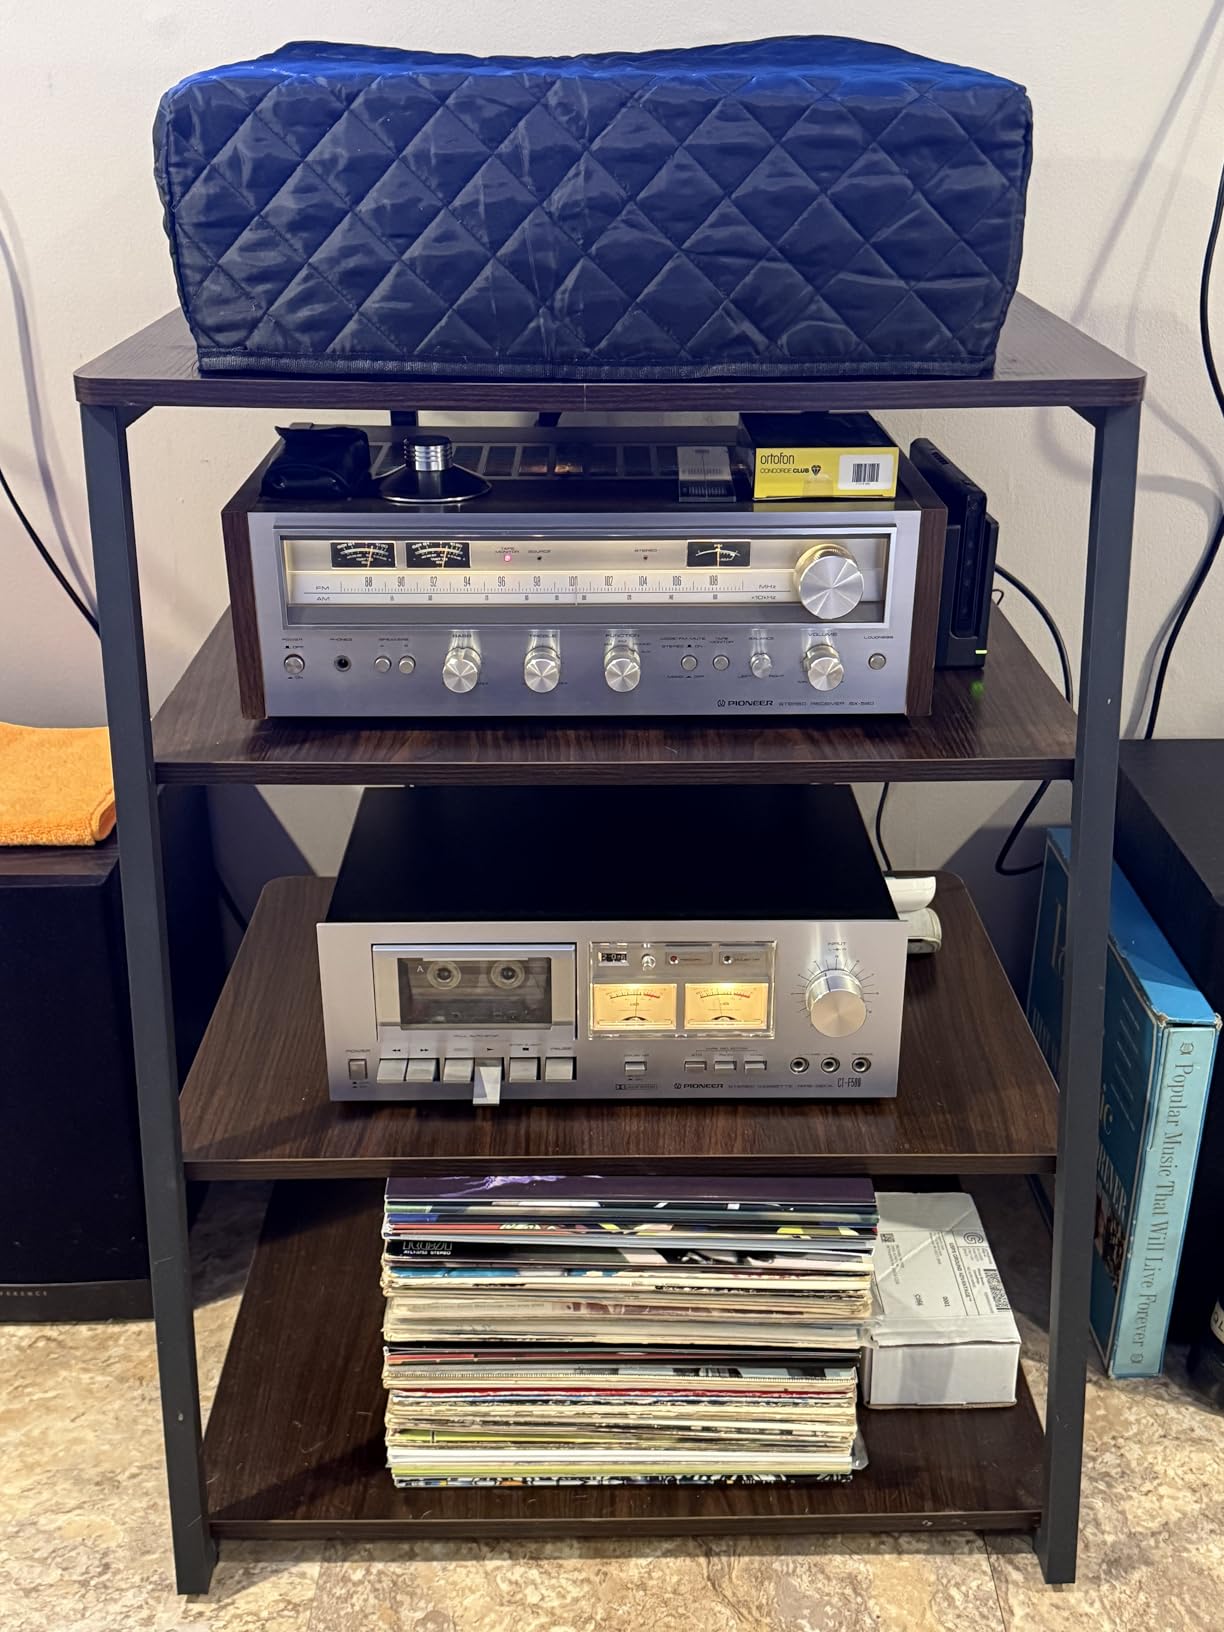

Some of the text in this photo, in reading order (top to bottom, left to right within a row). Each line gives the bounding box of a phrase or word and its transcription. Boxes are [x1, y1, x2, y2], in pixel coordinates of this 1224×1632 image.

[760, 452, 795, 465] ortofon
[364, 575, 719, 587] 88 90 92 94 96 98 100 102 104 106 108
[728, 699, 774, 707] PIONEER
[416, 965, 424, 973] A
[1132, 1063, 1194, 1348] Popular Music That Will Live Forever
[963, 1232, 984, 1244] G
[953, 1254, 963, 1272] GROUND
